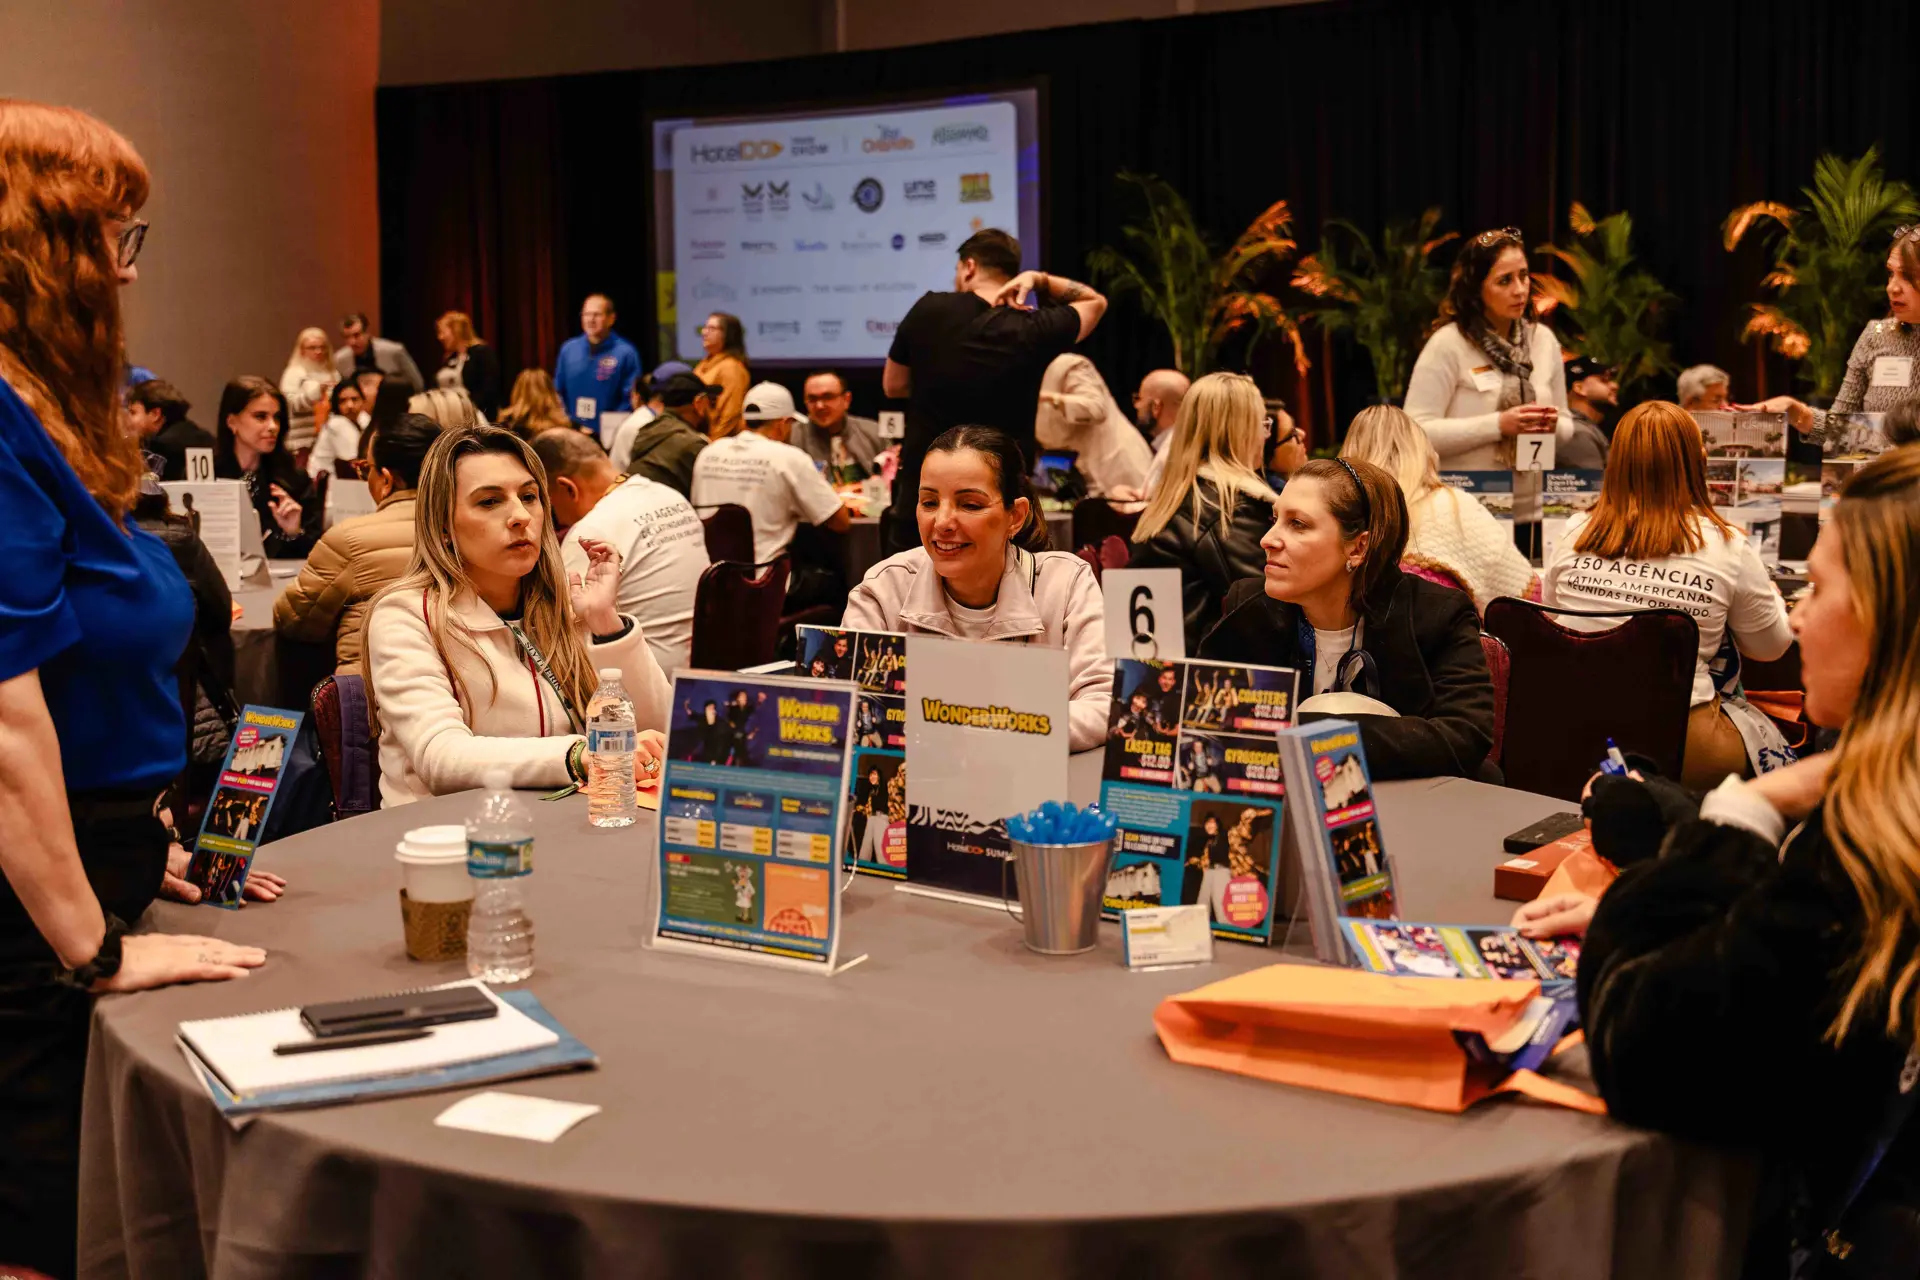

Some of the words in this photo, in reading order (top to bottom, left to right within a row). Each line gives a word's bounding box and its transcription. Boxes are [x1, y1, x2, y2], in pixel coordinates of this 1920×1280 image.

[1530, 441, 1543, 462] 7
[191, 454, 210, 480] 10
[1571, 557, 1603, 571] 150
[1608, 562, 1715, 592] AGÊNCIAS
[1567, 581, 1621, 600] REUNIDAS
[1625, 594, 1644, 605] EM
[1129, 585, 1155, 644] 6
[525, 642, 562, 691] SLYTERIN
[1238, 688, 1288, 707] COASTERS
[1125, 739, 1154, 755] LASER
[1155, 741, 1172, 756] TAG
[1225, 748, 1279, 769] GYROSCOPE
